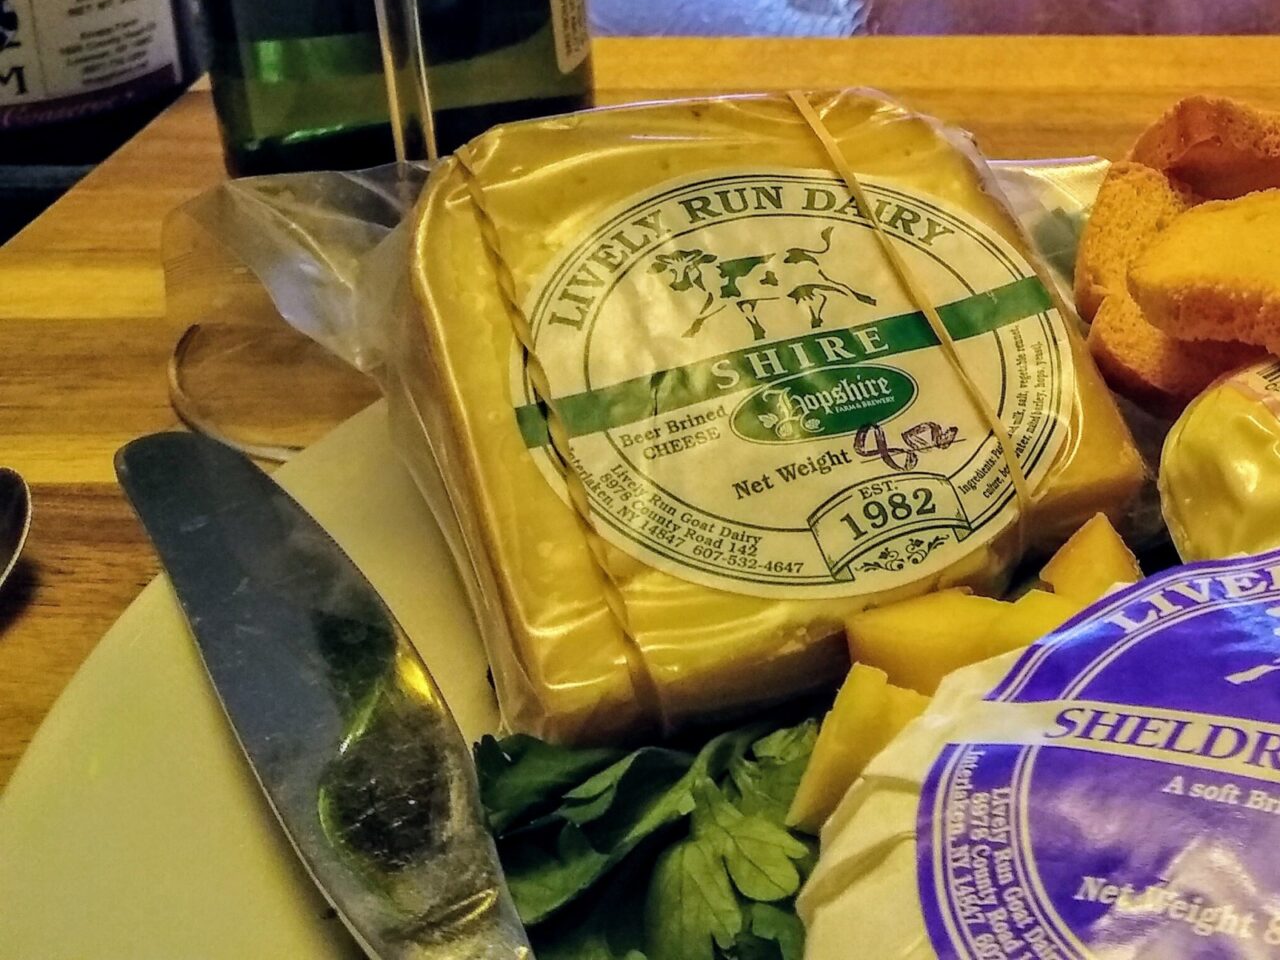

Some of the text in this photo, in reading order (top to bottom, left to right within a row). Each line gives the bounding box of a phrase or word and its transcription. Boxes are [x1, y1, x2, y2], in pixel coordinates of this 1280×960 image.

[548, 186, 955, 331] LIVELY RUN DAIRY
[711, 327, 889, 390] SHIRE
[619, 405, 729, 449] Beer Brined
[762, 375, 893, 430] Hopshire
[642, 426, 721, 461] CHEESE
[732, 448, 852, 500] Net Weight
[859, 480, 900, 500] EST.
[568, 447, 805, 575] nterlaken, NY 14847 607-532-4647
[599, 472, 758, 557] 8978 County Road 142
[610, 463, 763, 545] Lively Run Goat Dairy
[840, 487, 936, 541] 1982
[969, 791, 992, 841] 8978
[987, 787, 1011, 844] Lively
[1161, 775, 1187, 796] A
[1190, 781, 1241, 805] soft
[950, 749, 987, 925] Interlaken, NY 14847
[970, 844, 999, 906] County
[993, 847, 1015, 886] Run
[984, 906, 1026, 955] Road
[1002, 886, 1036, 929] Goat
[1073, 875, 1135, 906] Net
[1138, 882, 1257, 940] Weight
